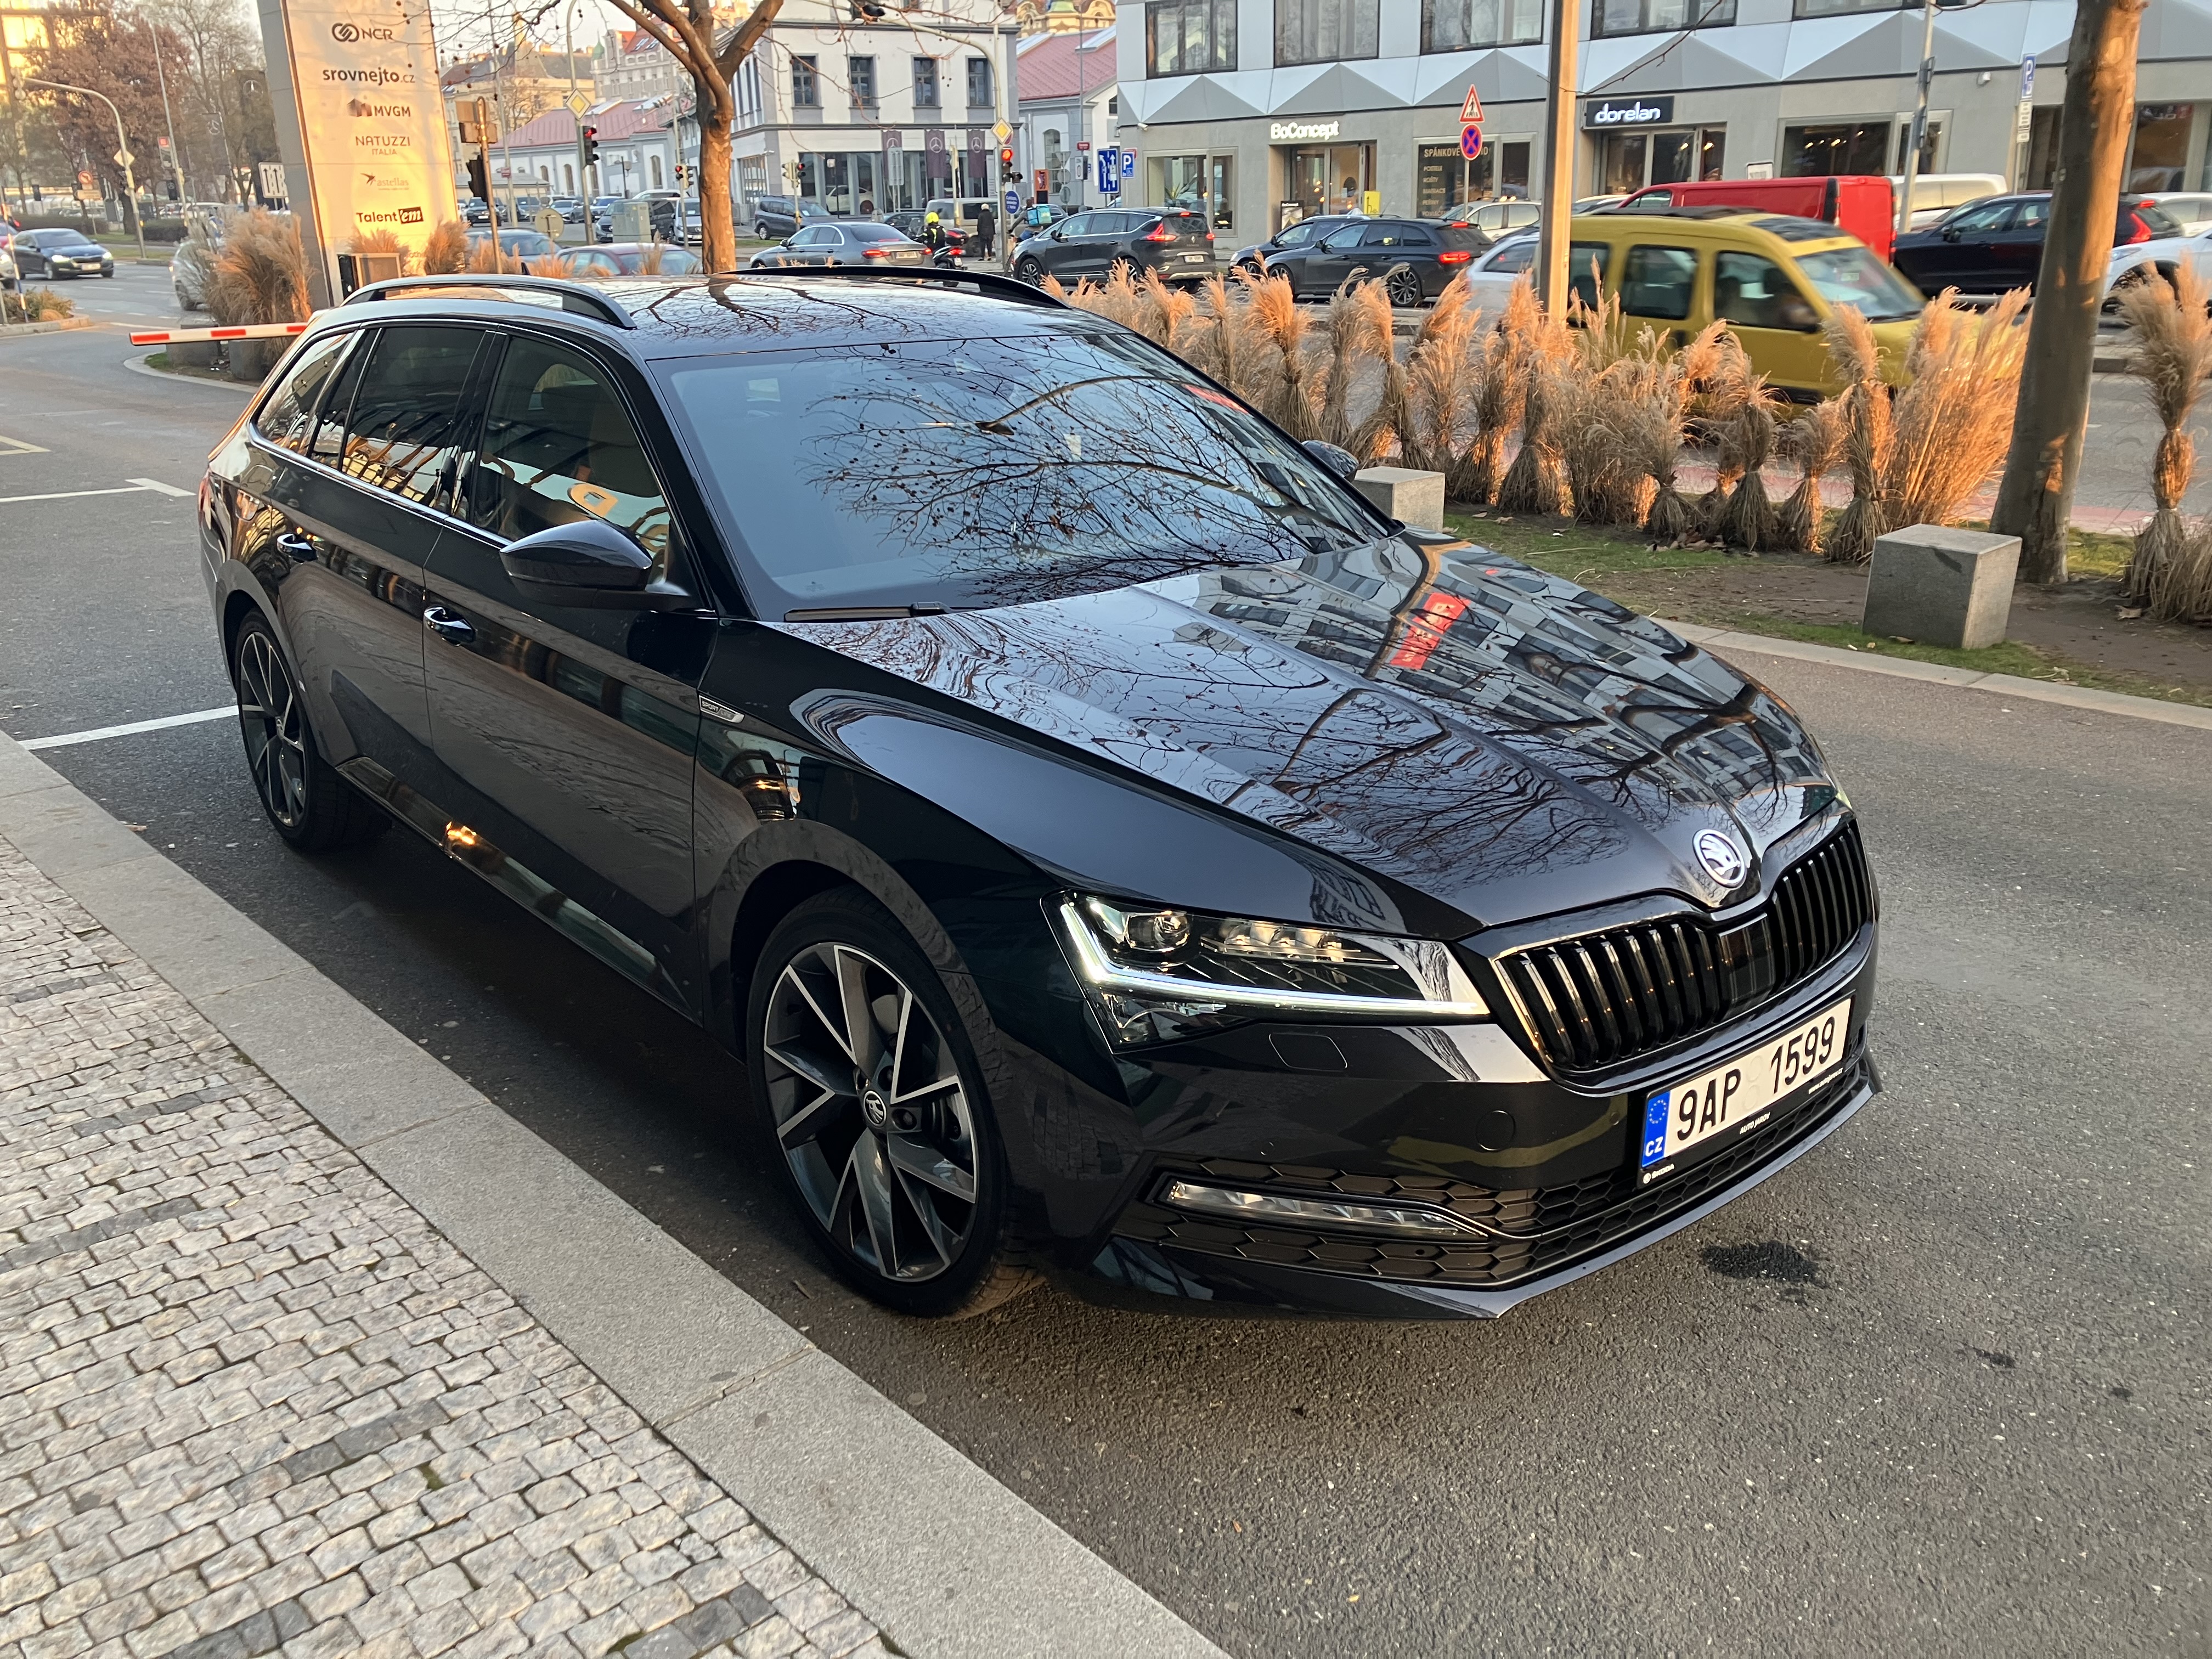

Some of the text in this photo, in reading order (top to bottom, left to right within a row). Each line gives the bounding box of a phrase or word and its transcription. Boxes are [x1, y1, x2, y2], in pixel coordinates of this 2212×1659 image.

[361, 28, 393, 40] NCR
[323, 67, 415, 86] srovnejto.cz
[374, 105, 411, 117] MVGM
[1595, 101, 1661, 123] dorelan
[1271, 121, 1339, 140] BoConcept
[356, 136, 411, 146] NATUZZI
[1424, 146, 1460, 157] SPÁNKOVÉ
[1123, 155, 1132, 170] P
[377, 177, 409, 187] astellas
[702, 700, 719, 712] SPORT
[1677, 1016, 1836, 1141] 9AP 1599
[1739, 1111, 1771, 1135] AUTO JAROV
[1645, 1137, 1663, 1156] CZ
